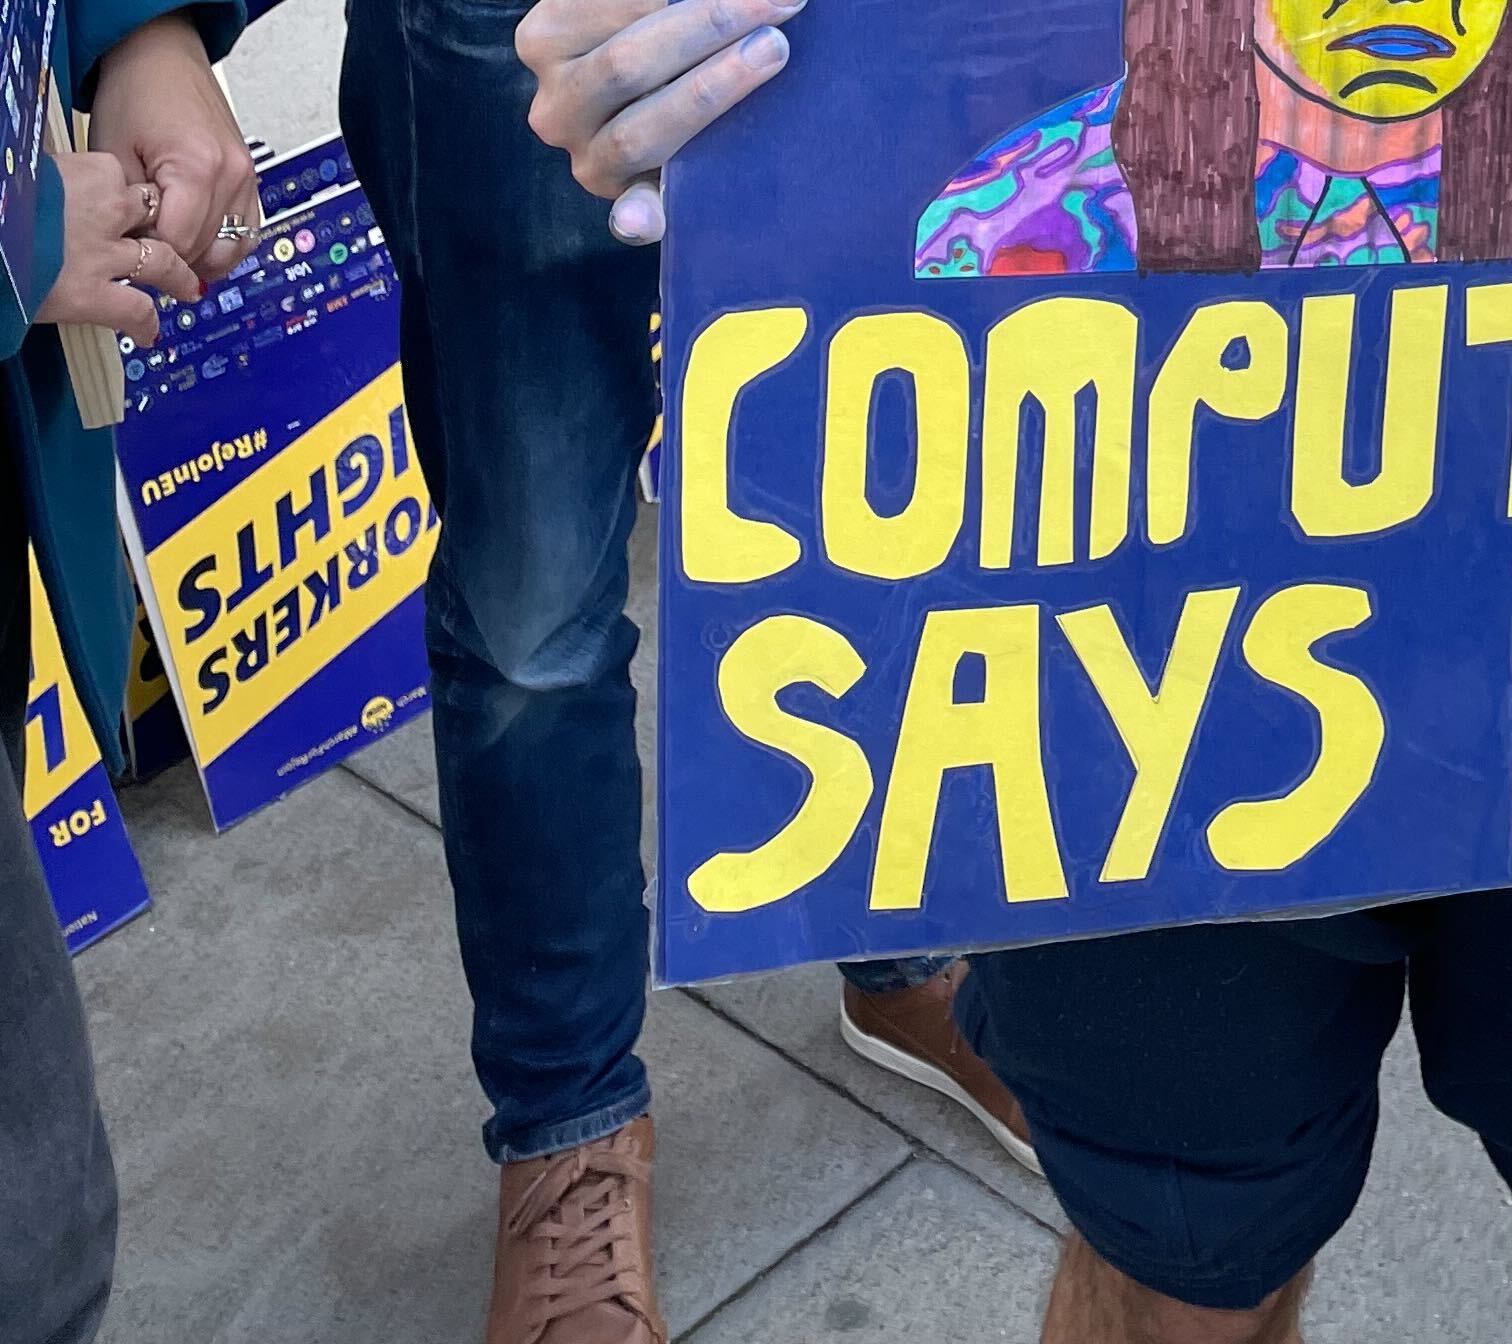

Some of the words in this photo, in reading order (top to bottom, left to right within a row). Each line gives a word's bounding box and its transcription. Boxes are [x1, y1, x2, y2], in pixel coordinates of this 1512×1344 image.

[285, 261, 313, 282] Volt
[141, 428, 268, 506] #RejoinEU
[689, 585, 1383, 911] SAYS
[49, 800, 107, 848] FOR
